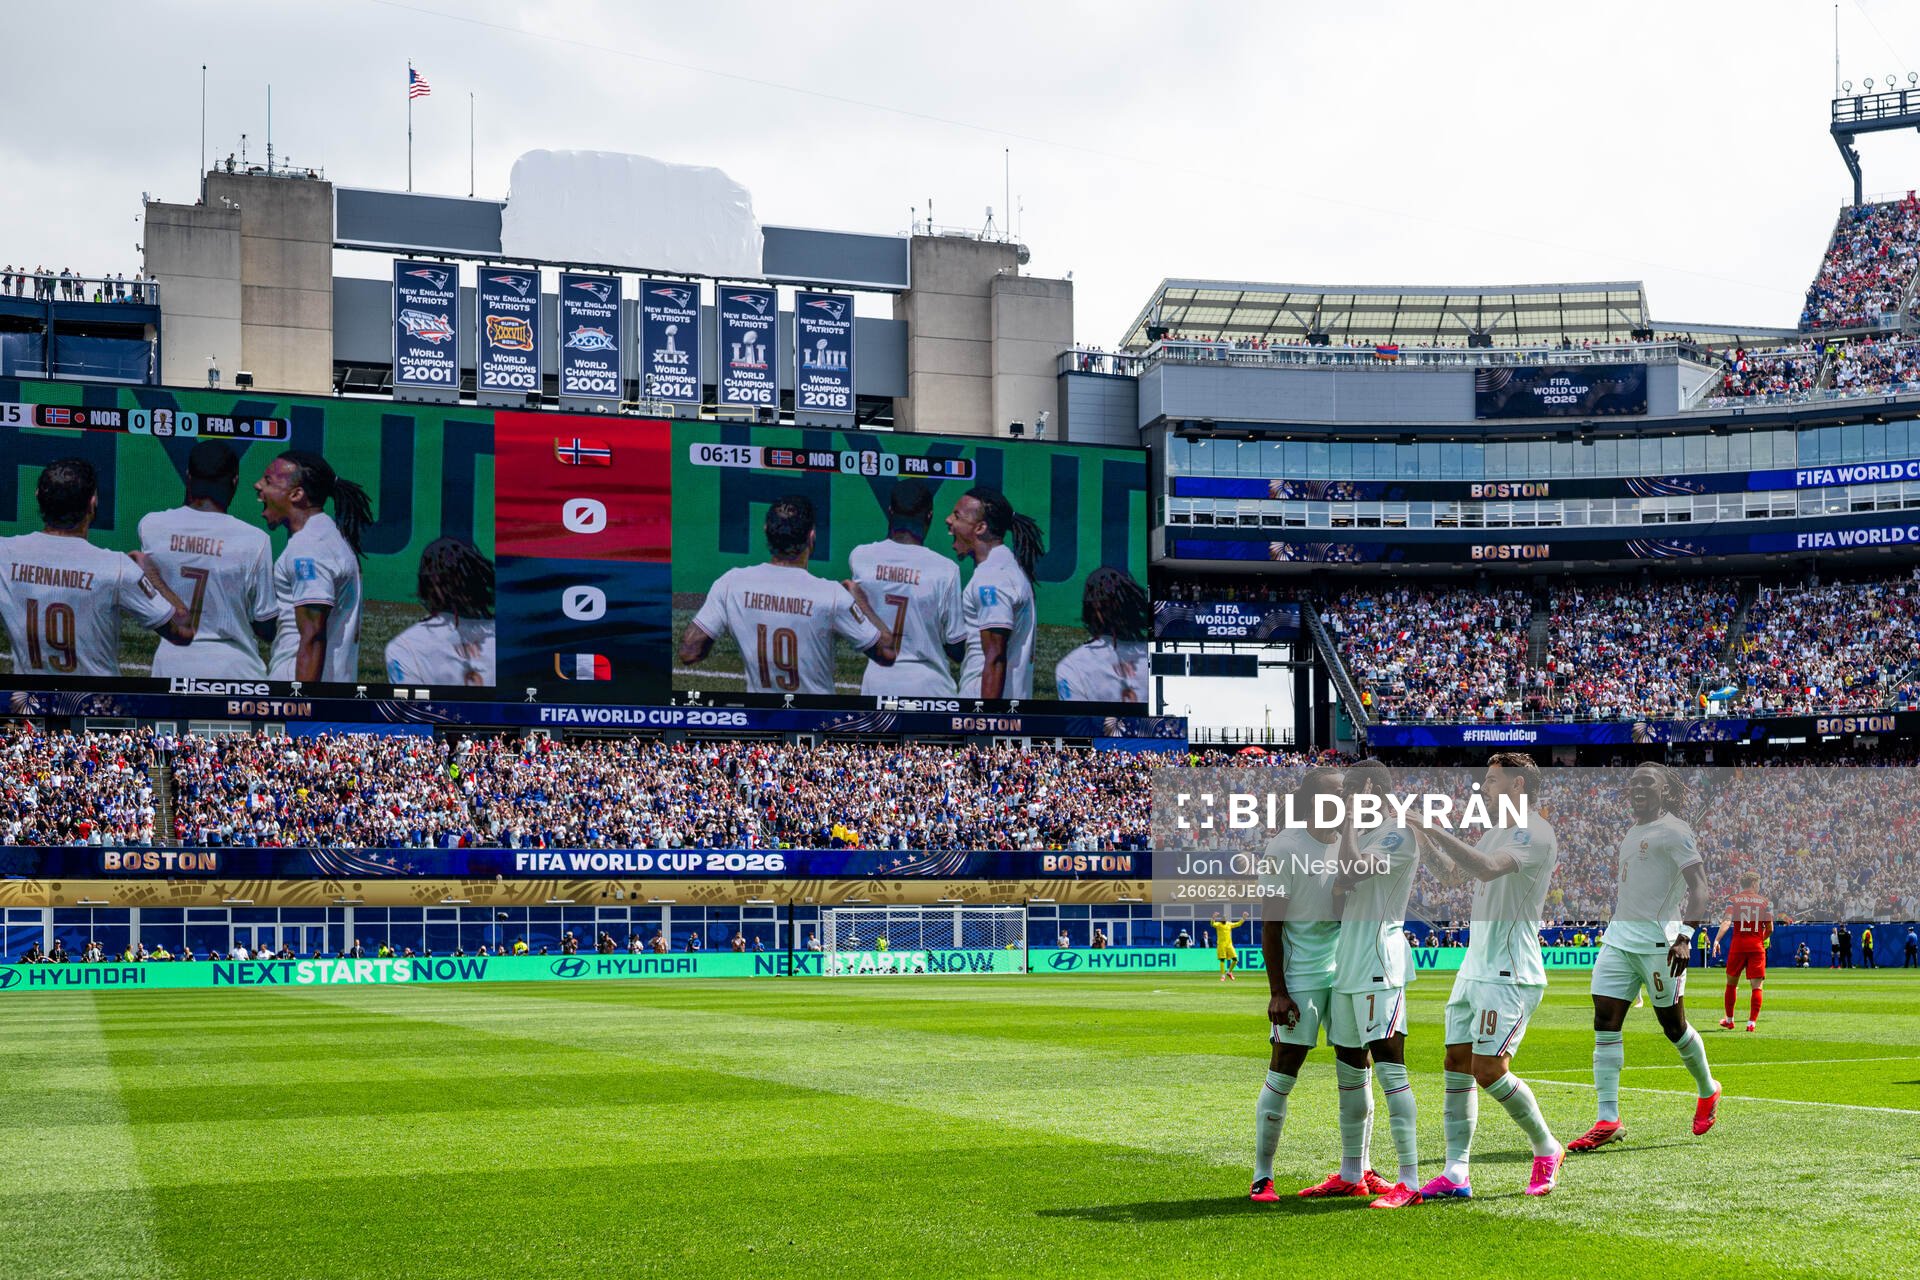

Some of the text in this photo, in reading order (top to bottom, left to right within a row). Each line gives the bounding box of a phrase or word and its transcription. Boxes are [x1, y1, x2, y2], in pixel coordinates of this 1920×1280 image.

[399, 287, 454, 298] NEW ENGLAND
[503, 295, 536, 304] ENGLAND
[406, 296, 448, 306] PATRIOTS
[489, 302, 530, 312] PATRIOTS
[584, 301, 617, 310] ENGLAND
[571, 308, 611, 318] PATRIOTS
[651, 314, 690, 323] PATRIOTS
[664, 307, 696, 316] ENGLAND
[742, 313, 774, 322] ENGLAND
[729, 319, 768, 329] PATRIOTS
[806, 325, 844, 335] PATRIOTS
[819, 319, 850, 328] ENGLAND
[409, 348, 444, 358] WORLD
[493, 354, 526, 364] WORLD
[653, 353, 689, 364] XLIX
[400, 357, 454, 368] CHAMPIONS
[483, 362, 536, 374] CHAMPIONS
[575, 360, 608, 369] WORLD
[655, 365, 687, 374] WORLD
[403, 366, 451, 382] 2001
[484, 372, 535, 387] 2003
[565, 368, 617, 379] CHAMPIONS
[733, 370, 765, 380] WORLD
[810, 375, 841, 384] WORLD
[566, 377, 616, 393] 2004
[724, 379, 774, 389] CHAMPIONS
[800, 383, 850, 394] CHAMPIONS
[1550, 378, 1571, 386] FIFA
[651, 383, 693, 397] 2014
[728, 388, 771, 402] 2016
[1533, 386, 1589, 395] WORLD CUP
[804, 393, 847, 407] 2018
[1543, 395, 1578, 404] 2026
[90, 410, 121, 427] NOR
[134, 414, 145, 430] 0
[182, 417, 192, 432] 0
[206, 417, 234, 433] FRA
[700, 446, 929, 473] 06:15 NOR 0 0 FRA
[1796, 462, 1920, 486] FIFA WORLD C
[1471, 483, 1549, 498] BOSTON
[1797, 526, 1920, 549] FIFA WORLD C
[170, 534, 224, 557] DEMBELE
[1471, 545, 1550, 560] BOSTON
[11, 562, 94, 591] T.HERNANDEZ
[876, 564, 921, 587] DEMBELE
[180, 566, 209, 632] 7
[744, 591, 813, 617] T.HERNANDEZ
[1215, 605, 1240, 615] FIFA
[884, 594, 909, 654] 7
[1195, 615, 1261, 626] WORLD CUP
[26, 598, 77, 673] 19
[1207, 626, 1248, 637] 2026
[756, 623, 799, 691] 19
[169, 677, 270, 697] Hisense
[227, 700, 311, 717] BOSTON
[877, 696, 960, 713] Hisense
[540, 708, 748, 726] FIFA WORLD CUP 2026
[952, 717, 1022, 732] BOSTON
[1817, 716, 1895, 735] BOSTON
[1463, 728, 1537, 743] #FIFAWorldCup
[104, 851, 217, 871] BOSTON
[516, 853, 784, 871] FIFA WORLD CUP 2026
[1043, 855, 1132, 872] BOSTON
[1739, 905, 1759, 932] 21
[597, 958, 697, 975] HYUNDAI
[1089, 952, 1176, 968] HYUNDAI
[29, 968, 146, 985] HYUNDAI
[1653, 971, 1665, 993] 6
[1479, 1009, 1498, 1036] 19
